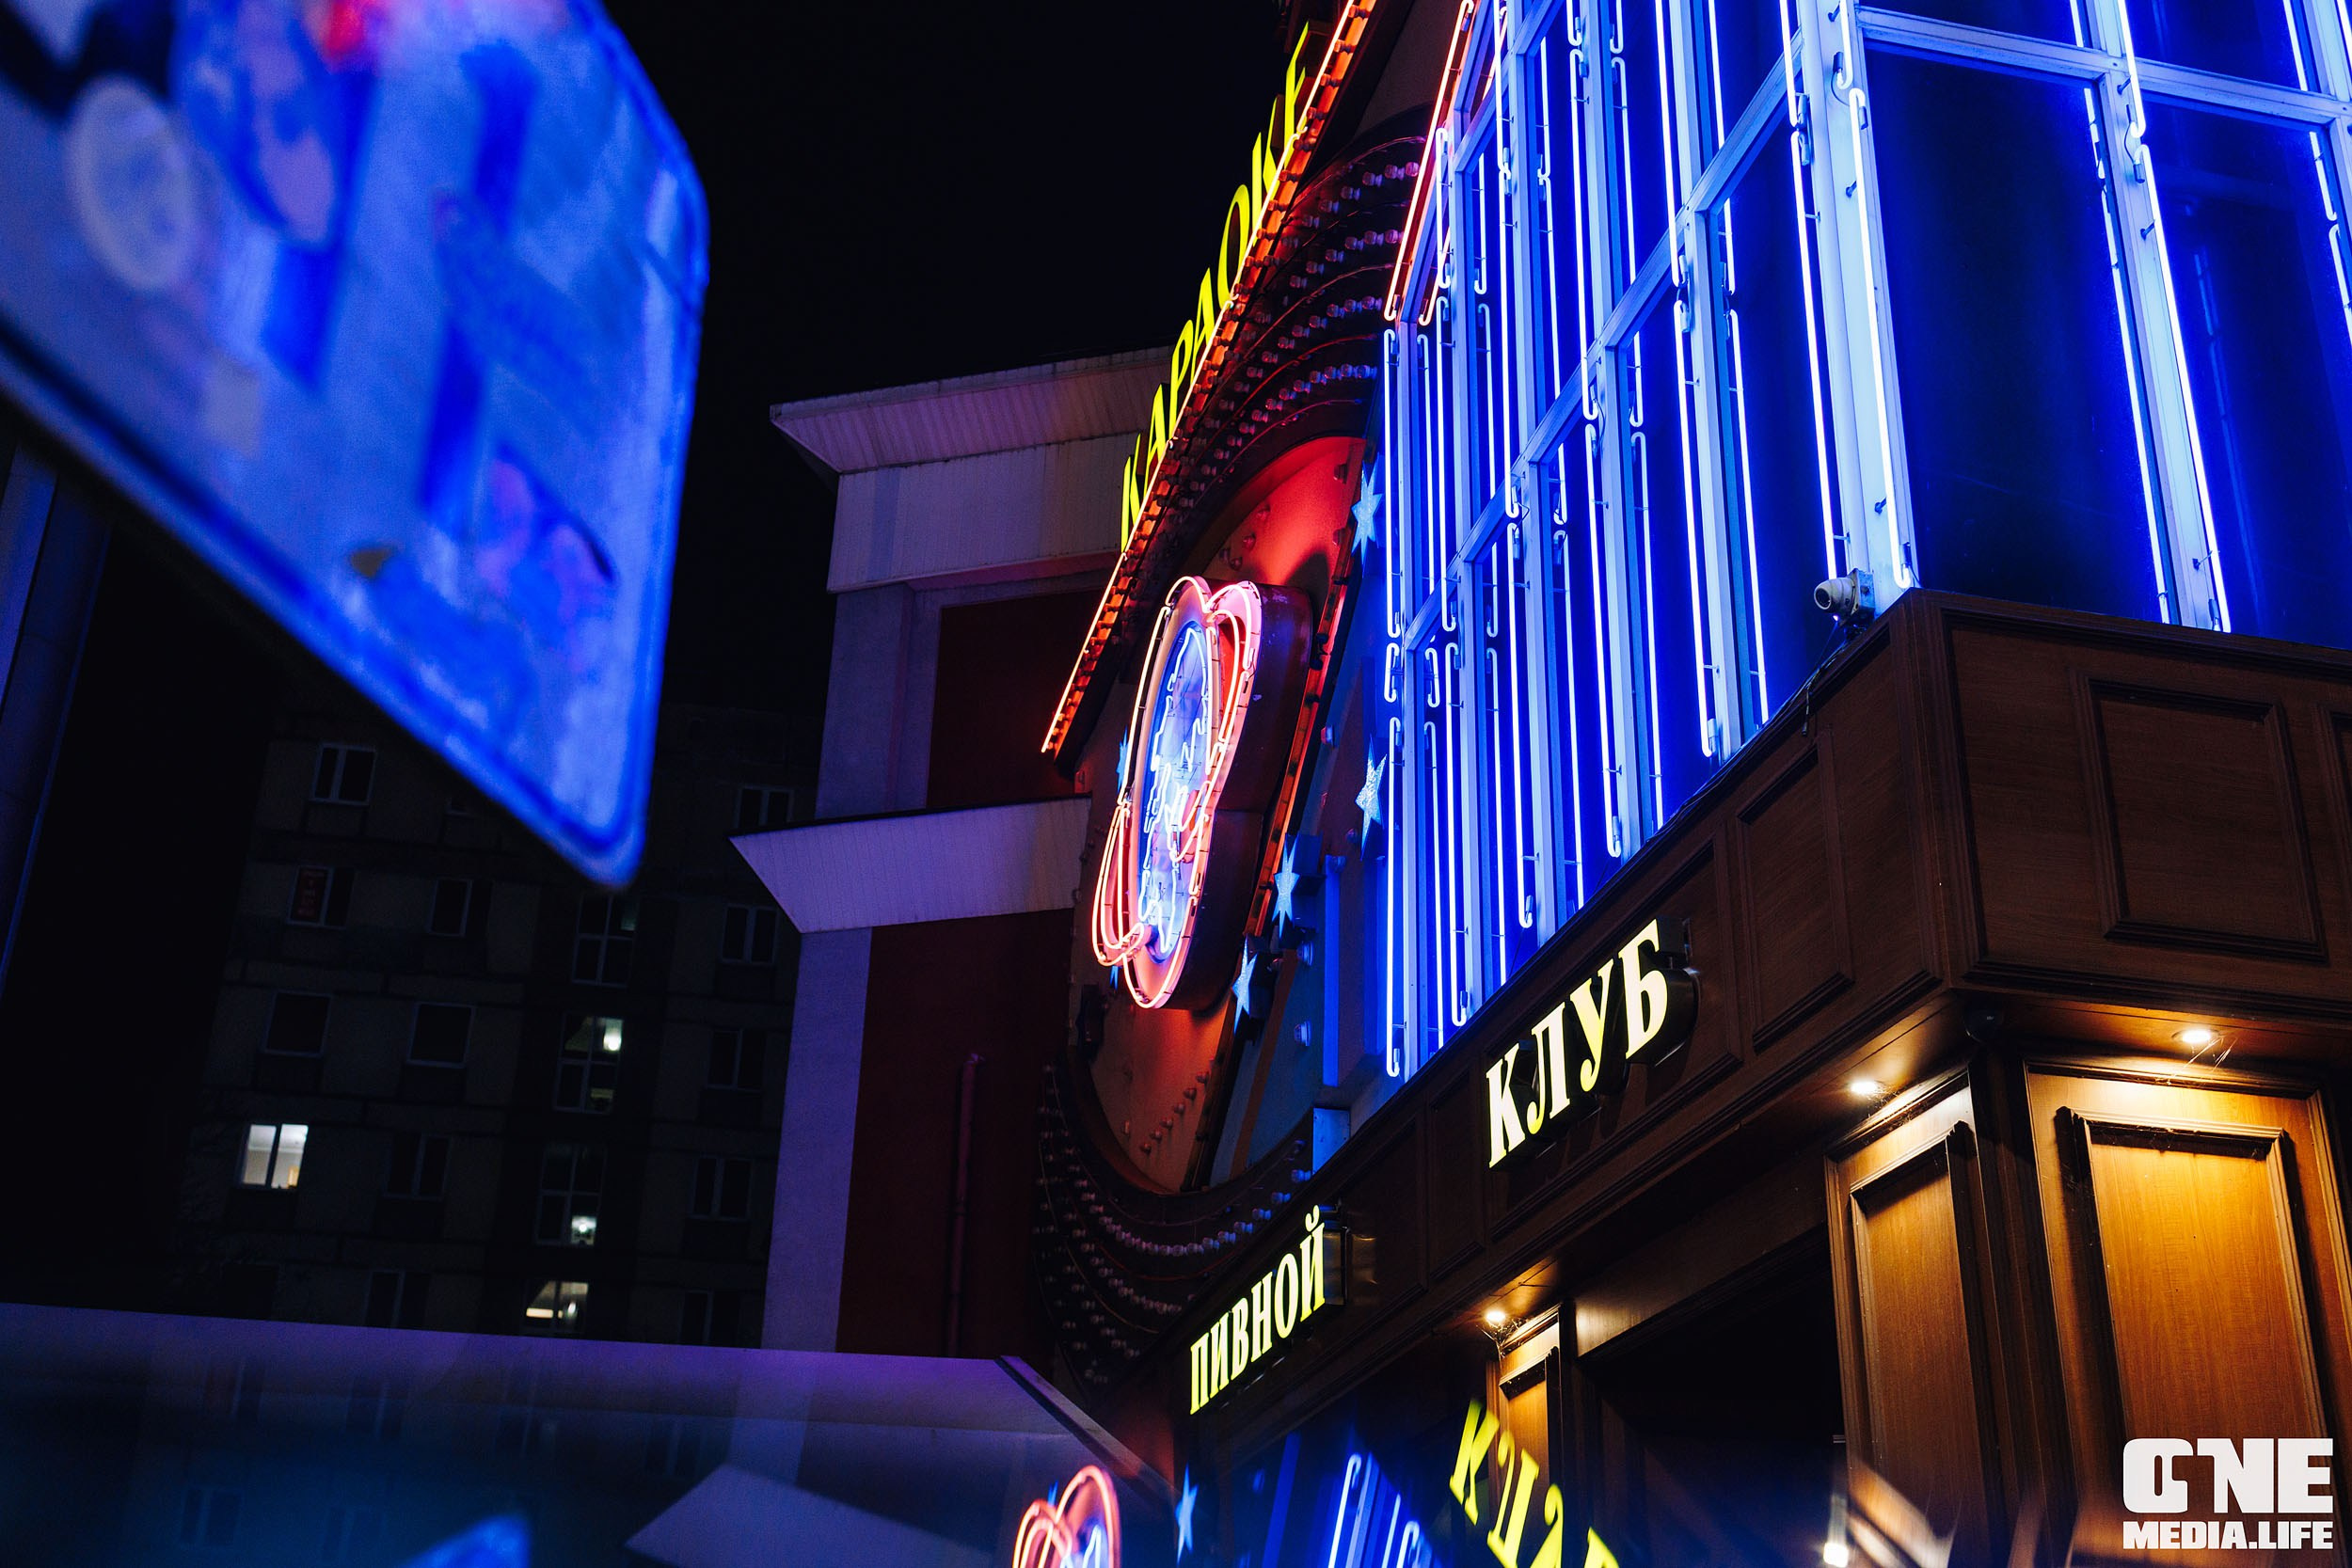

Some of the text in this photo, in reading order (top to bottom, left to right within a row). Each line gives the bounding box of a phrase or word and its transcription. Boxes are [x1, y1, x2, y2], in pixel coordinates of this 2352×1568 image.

[1120, 21, 1309, 553] КАРАОКЕ
[1189, 918, 1669, 1415] ПИВНОЙ КЛУБ
